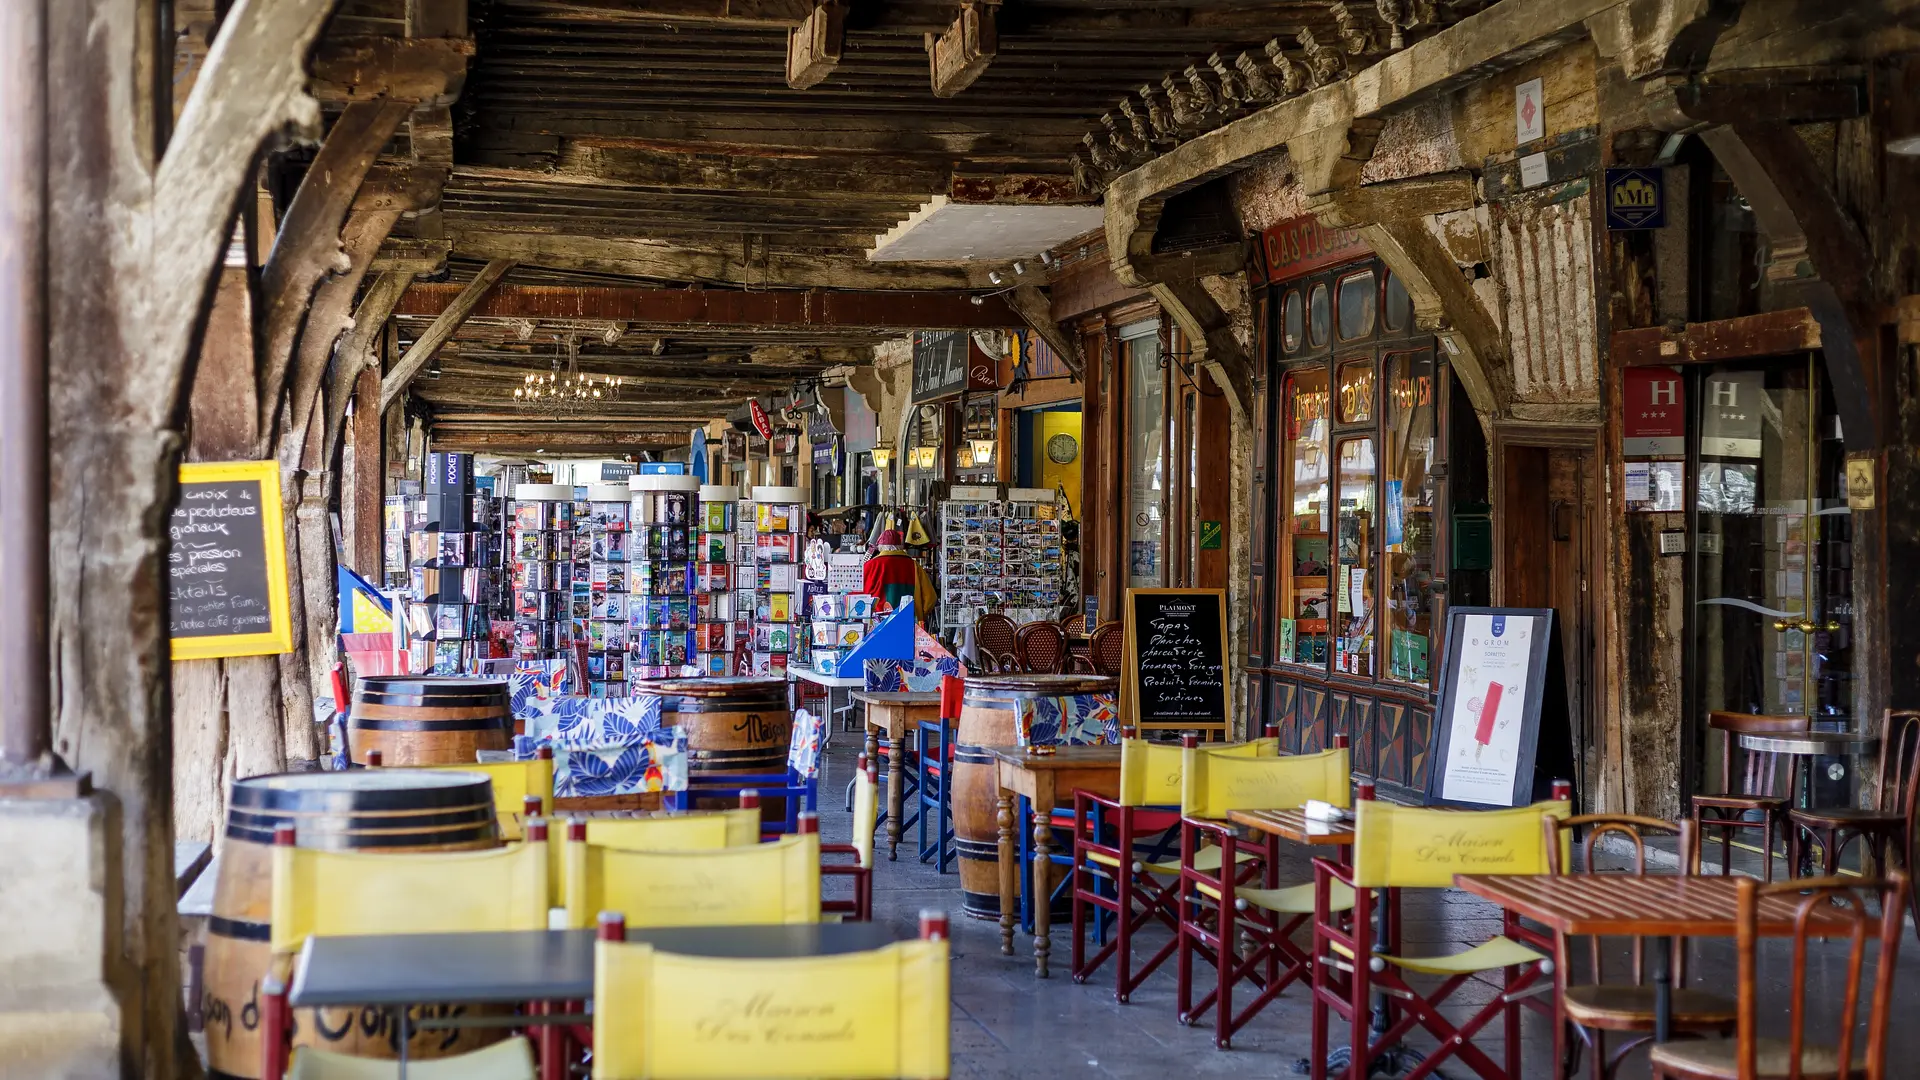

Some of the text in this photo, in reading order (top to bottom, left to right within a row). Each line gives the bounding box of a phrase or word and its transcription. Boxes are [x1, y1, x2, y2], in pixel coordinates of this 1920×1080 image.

[1616, 188, 1653, 204] VMF
[970, 364, 995, 386] Bar
[1650, 380, 1678, 405] H
[753, 404, 770, 434] TABAC
[447, 453, 458, 485] POCKET
[189, 503, 256, 525] producteurs
[170, 522, 230, 540] gionaux
[189, 548, 242, 566] pression
[197, 600, 226, 616] petites
[1150, 618, 1190, 634] Tapas
[1150, 634, 1202, 645] Planches
[1143, 674, 1185, 687] Produits
[1158, 692, 1204, 702] Sardines
[734, 714, 787, 744] Maison
[1432, 829, 1504, 848] Maison
[1459, 849, 1516, 864] Consuls
[205, 991, 232, 1042] son
